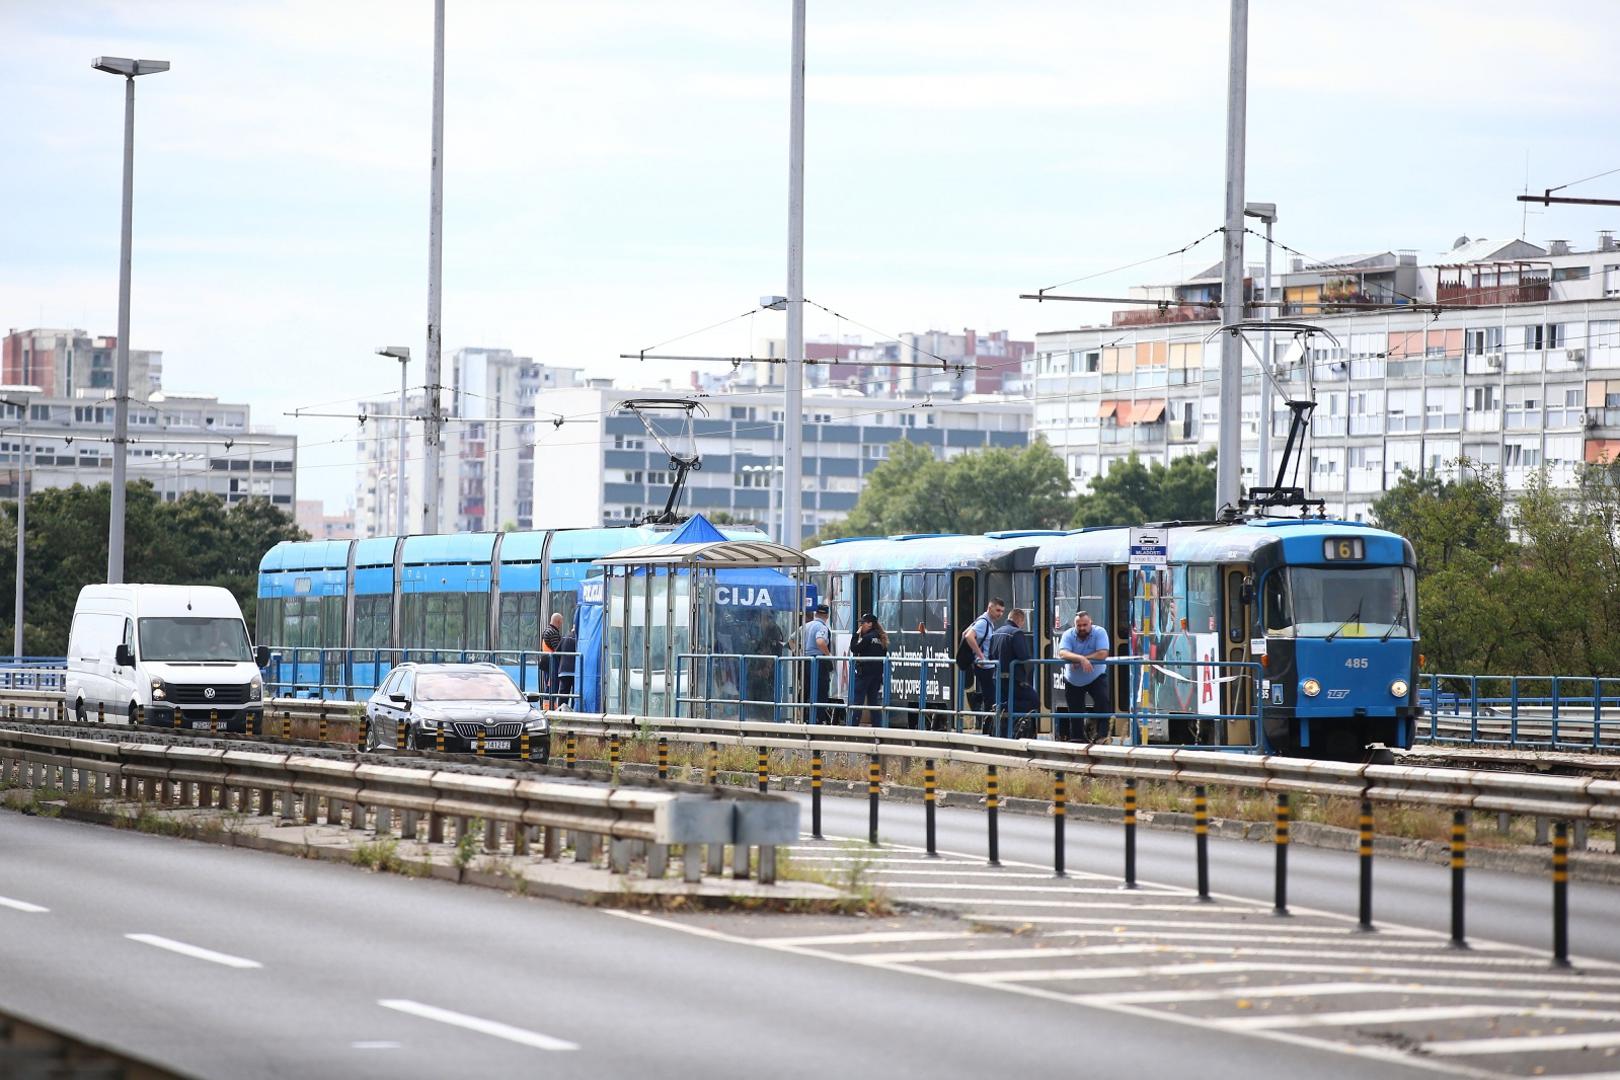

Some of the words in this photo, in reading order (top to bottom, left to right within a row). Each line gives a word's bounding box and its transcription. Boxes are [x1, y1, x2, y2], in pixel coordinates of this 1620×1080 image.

[1339, 542, 1351, 559] 6
[713, 586, 773, 607] CIJA
[1345, 658, 1369, 669] 485
[1327, 689, 1350, 699] ZET
